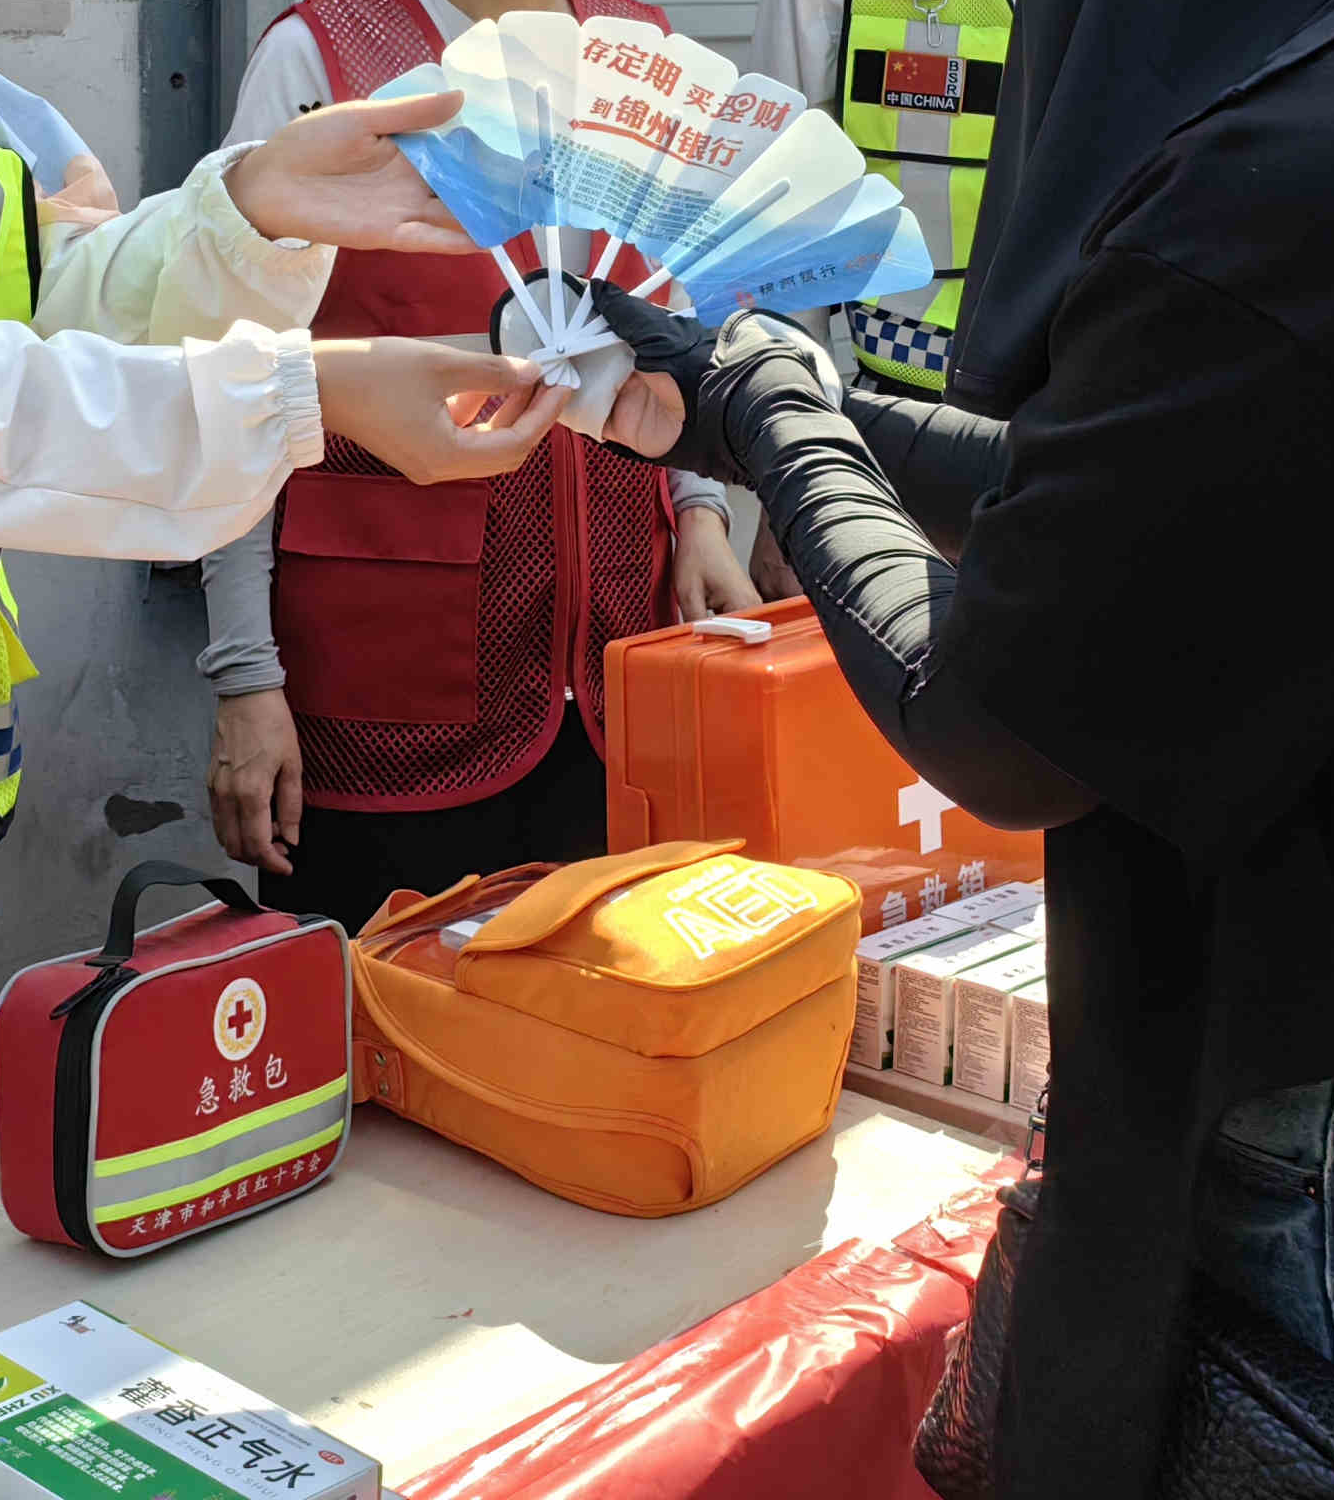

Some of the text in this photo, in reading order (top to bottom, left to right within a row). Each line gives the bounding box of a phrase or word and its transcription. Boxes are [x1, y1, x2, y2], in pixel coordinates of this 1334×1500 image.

[582, 36, 792, 133] 存定期 买理财
[946, 59, 960, 97] BSR
[588, 93, 746, 168] 到锦州银行
[662, 864, 819, 960] AED
[879, 859, 987, 931] 急救箱
[194, 1053, 288, 1117] 急救包
[127, 1152, 322, 1236] 天津市和平区红十字会
[30, 1383, 63, 1402] XIU
[117, 1377, 316, 1490] 藿香正气水
